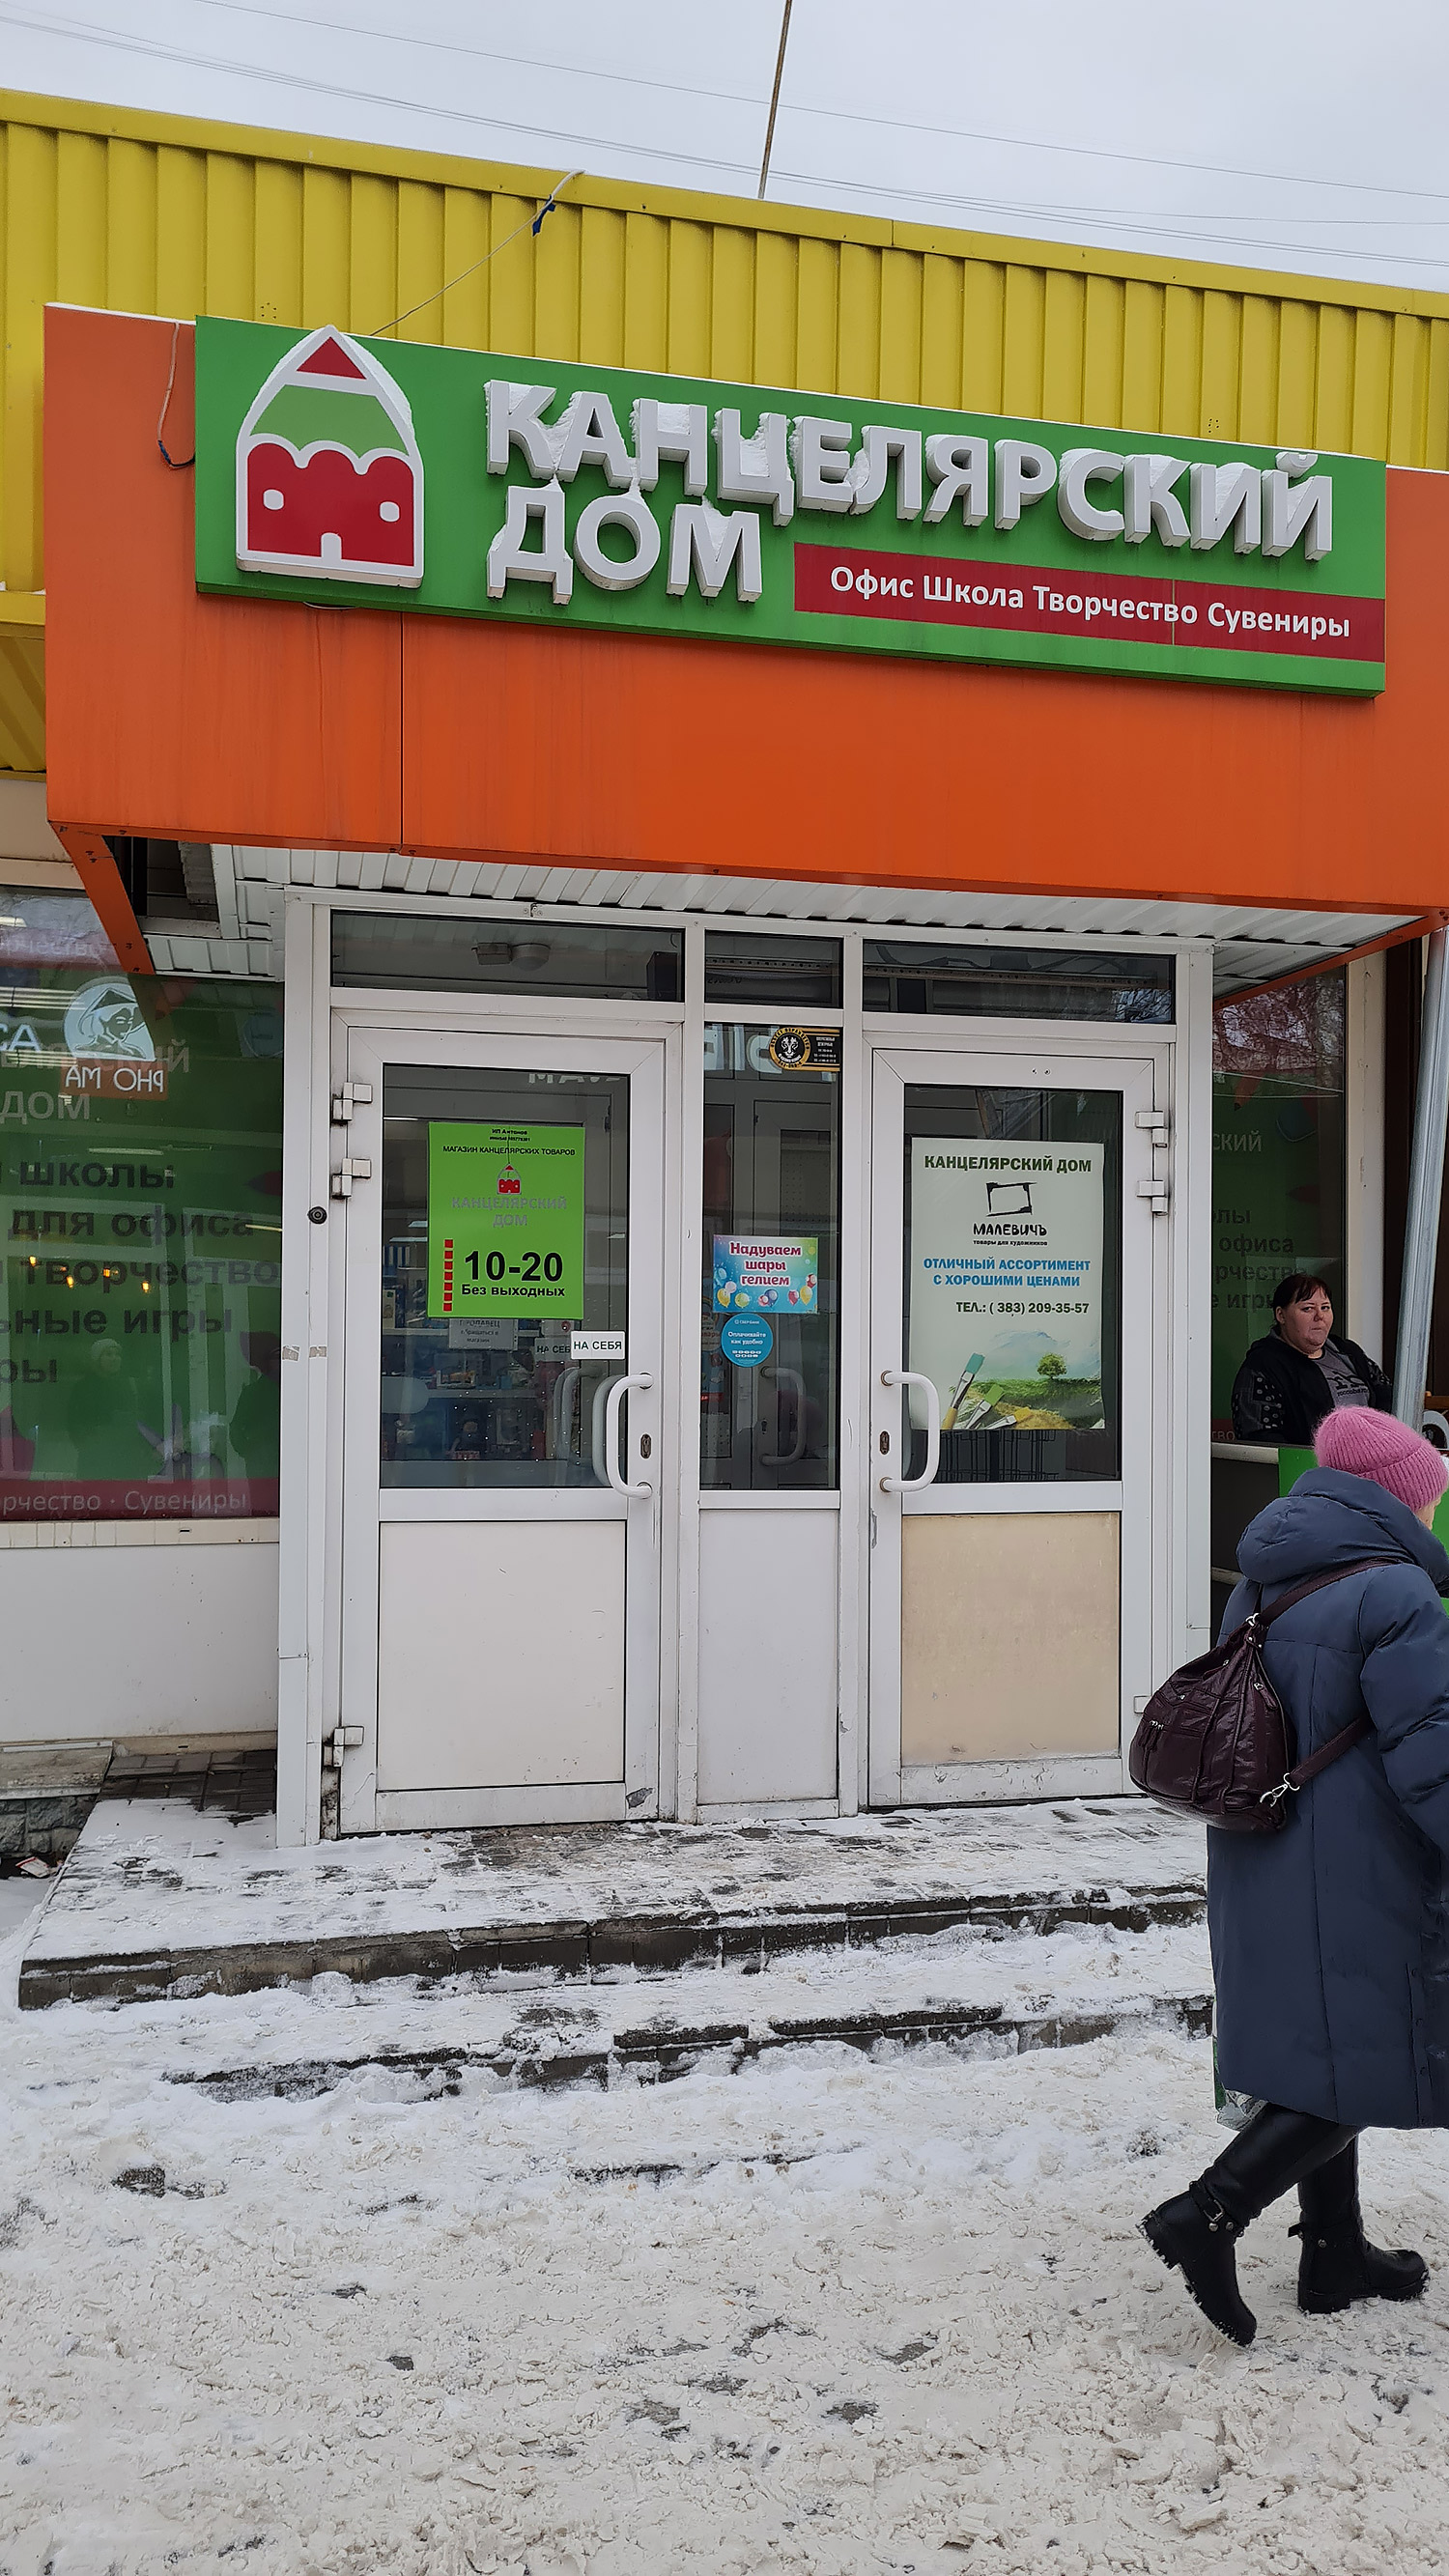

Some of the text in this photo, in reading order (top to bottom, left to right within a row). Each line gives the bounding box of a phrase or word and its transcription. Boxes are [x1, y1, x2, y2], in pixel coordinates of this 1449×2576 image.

[485, 380, 1333, 561] КАНЦЕЛЯРСКИЙ
[487, 485, 762, 606] ДОМ
[830, 565, 1350, 639] Офис Школа Творчество Сувениры
[1, 1090, 90, 1124] ДОМ
[479, 1146, 540, 1155] КАНЦЕЛЯРСКИХ
[541, 1147, 576, 1156] ТОВАРОВ
[924, 1155, 1092, 1174] КАНЦЕЛЯРСКИЙ ДОМ
[19, 1161, 175, 1188] школы
[451, 1197, 567, 1210] КАНЦЕЛЯРСКИЙ
[8, 1204, 254, 1246] для офиса
[493, 1214, 527, 1228] ДОМ
[973, 1224, 1047, 1236] МАЛЕВИЧЪ
[729, 1242, 802, 1258] Надуваем
[1218, 1232, 1293, 1257] офиса
[464, 1250, 563, 1282] 10-20
[745, 1260, 786, 1273] шары
[923, 1257, 1091, 1271] ОТЛИЧНЫЙ АССОРТИМЕНТ
[21, 1260, 278, 1293] творчество
[741, 1276, 789, 1286] гелием
[933, 1275, 1080, 1288] С ХОРОШИМИ ЦЕНАМИ
[461, 1284, 566, 1298] Без выходных
[956, 1302, 986, 1313] ТЕЛ.:
[1028, 1303, 1090, 1314] 209-35-57
[124, 1309, 232, 1342] игры
[573, 1341, 622, 1350] НА СЕБЯ
[125, 1491, 246, 1514] Сувениры
